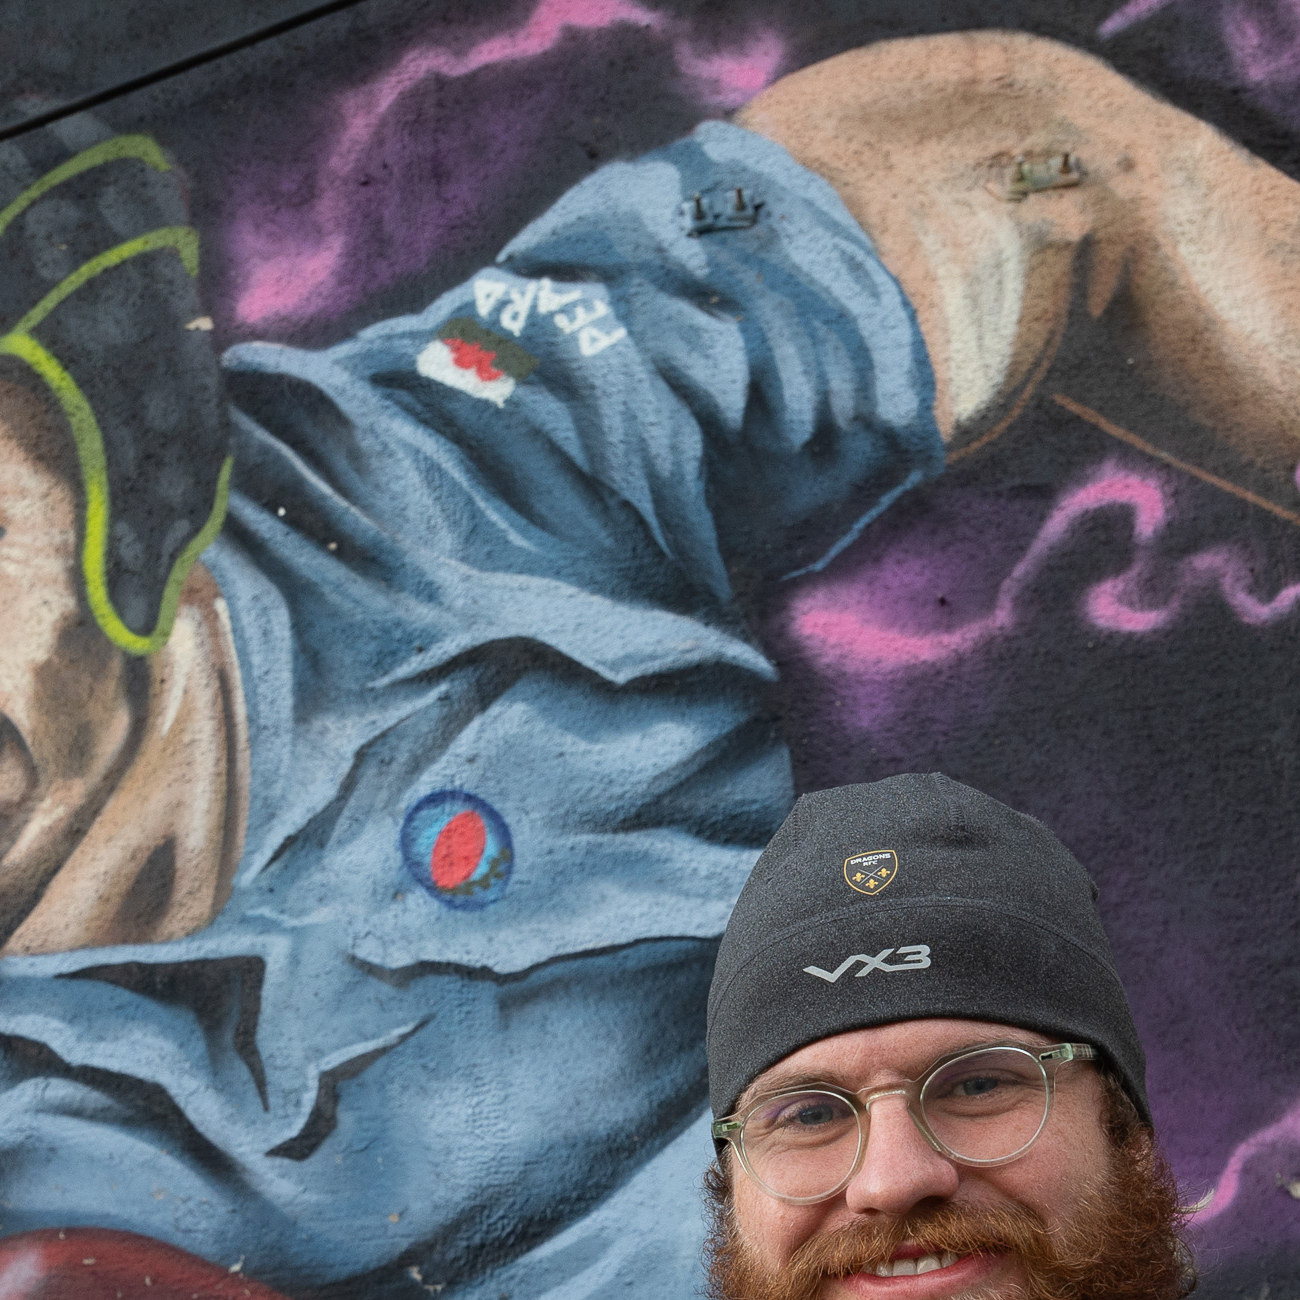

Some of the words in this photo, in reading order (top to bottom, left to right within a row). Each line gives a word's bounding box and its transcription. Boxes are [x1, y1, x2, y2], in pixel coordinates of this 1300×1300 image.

[473, 277, 628, 357] PEARD
[850, 853, 891, 865] DRAGONS
[802, 944, 932, 983] VX3
